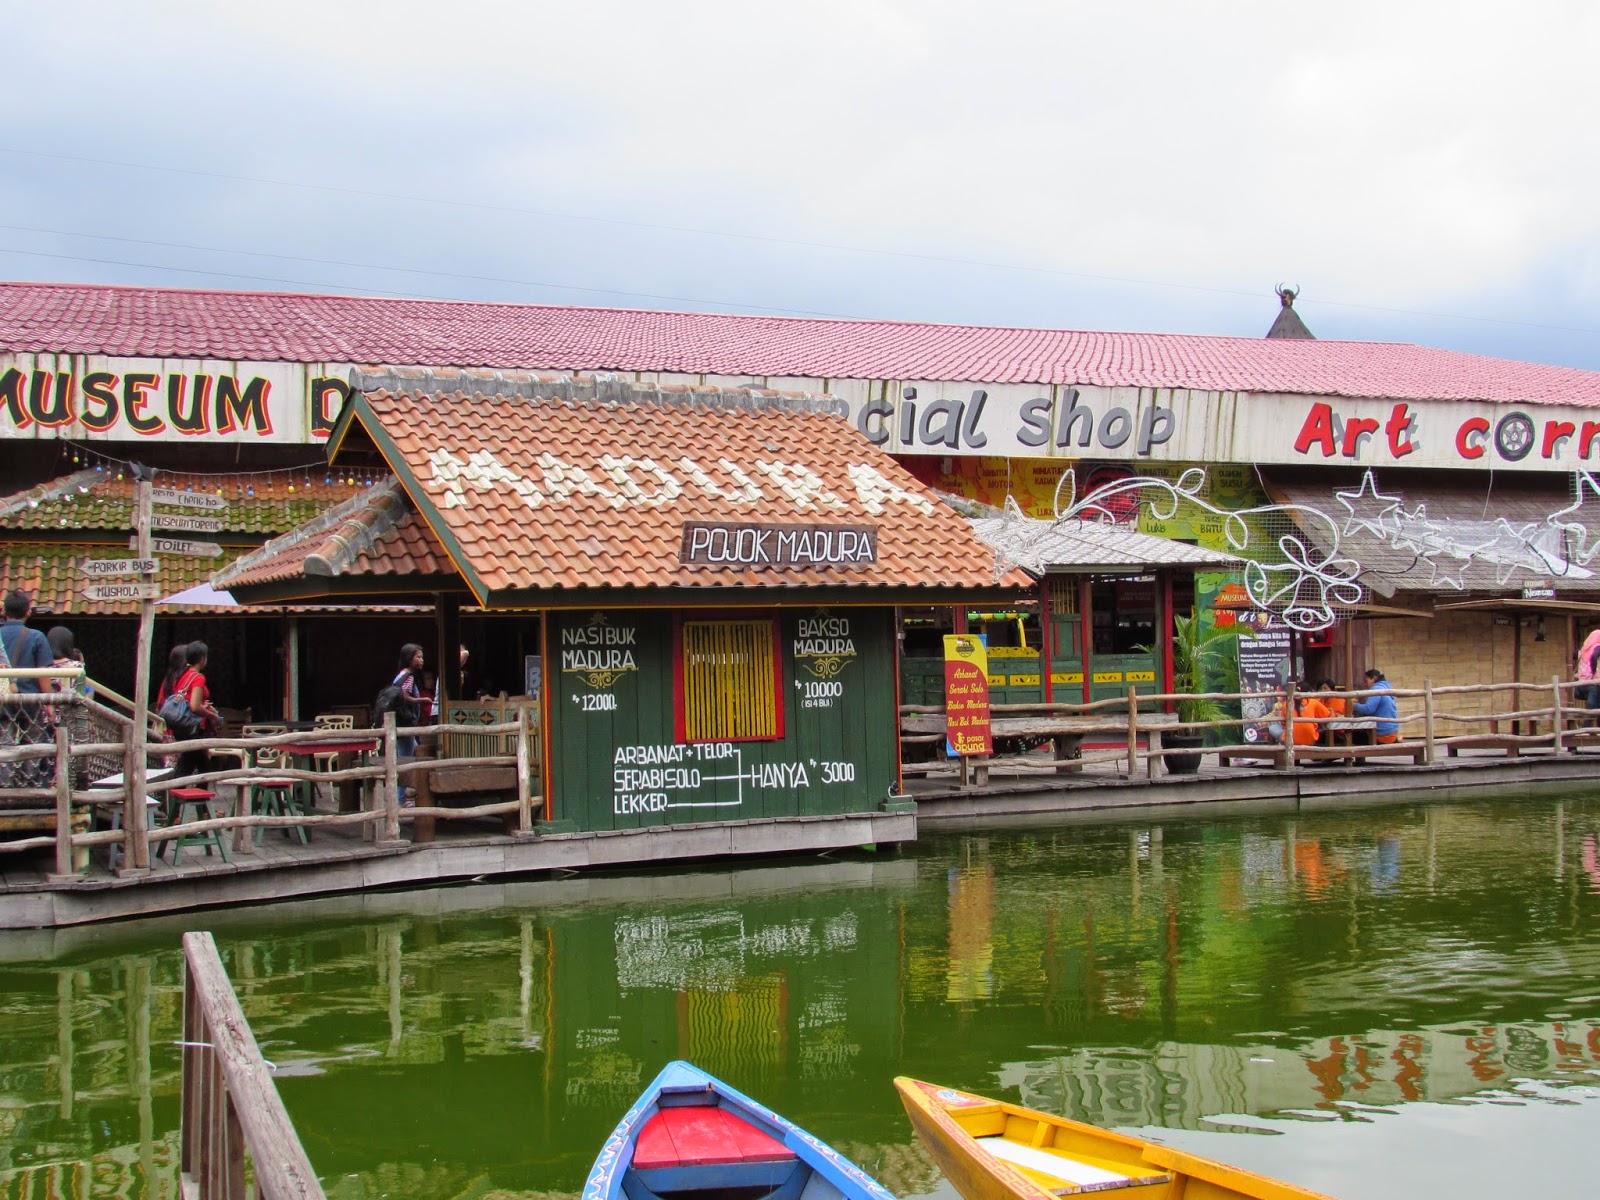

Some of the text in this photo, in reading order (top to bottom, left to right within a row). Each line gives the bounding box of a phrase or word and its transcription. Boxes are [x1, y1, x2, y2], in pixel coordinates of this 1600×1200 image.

[1294, 402, 1418, 461] Art
[428, 447, 934, 515] MADURA
[690, 527, 874, 563] POJOK MADURA
[132, 560, 155, 571] BUS
[97, 586, 140, 597] MUSHOLA
[1221, 594, 1247, 602] MUSEUM
[798, 618, 850, 637] BAKSO
[793, 638, 856, 655] MADURA
[562, 649, 636, 669] MADURA
[970, 682, 984, 694] Solo
[614, 744, 686, 765] ARBANAT
[693, 743, 733, 760] TELOR
[751, 762, 810, 788] HANYA
[821, 762, 855, 784] 3000
[614, 793, 668, 814] LEKKER
